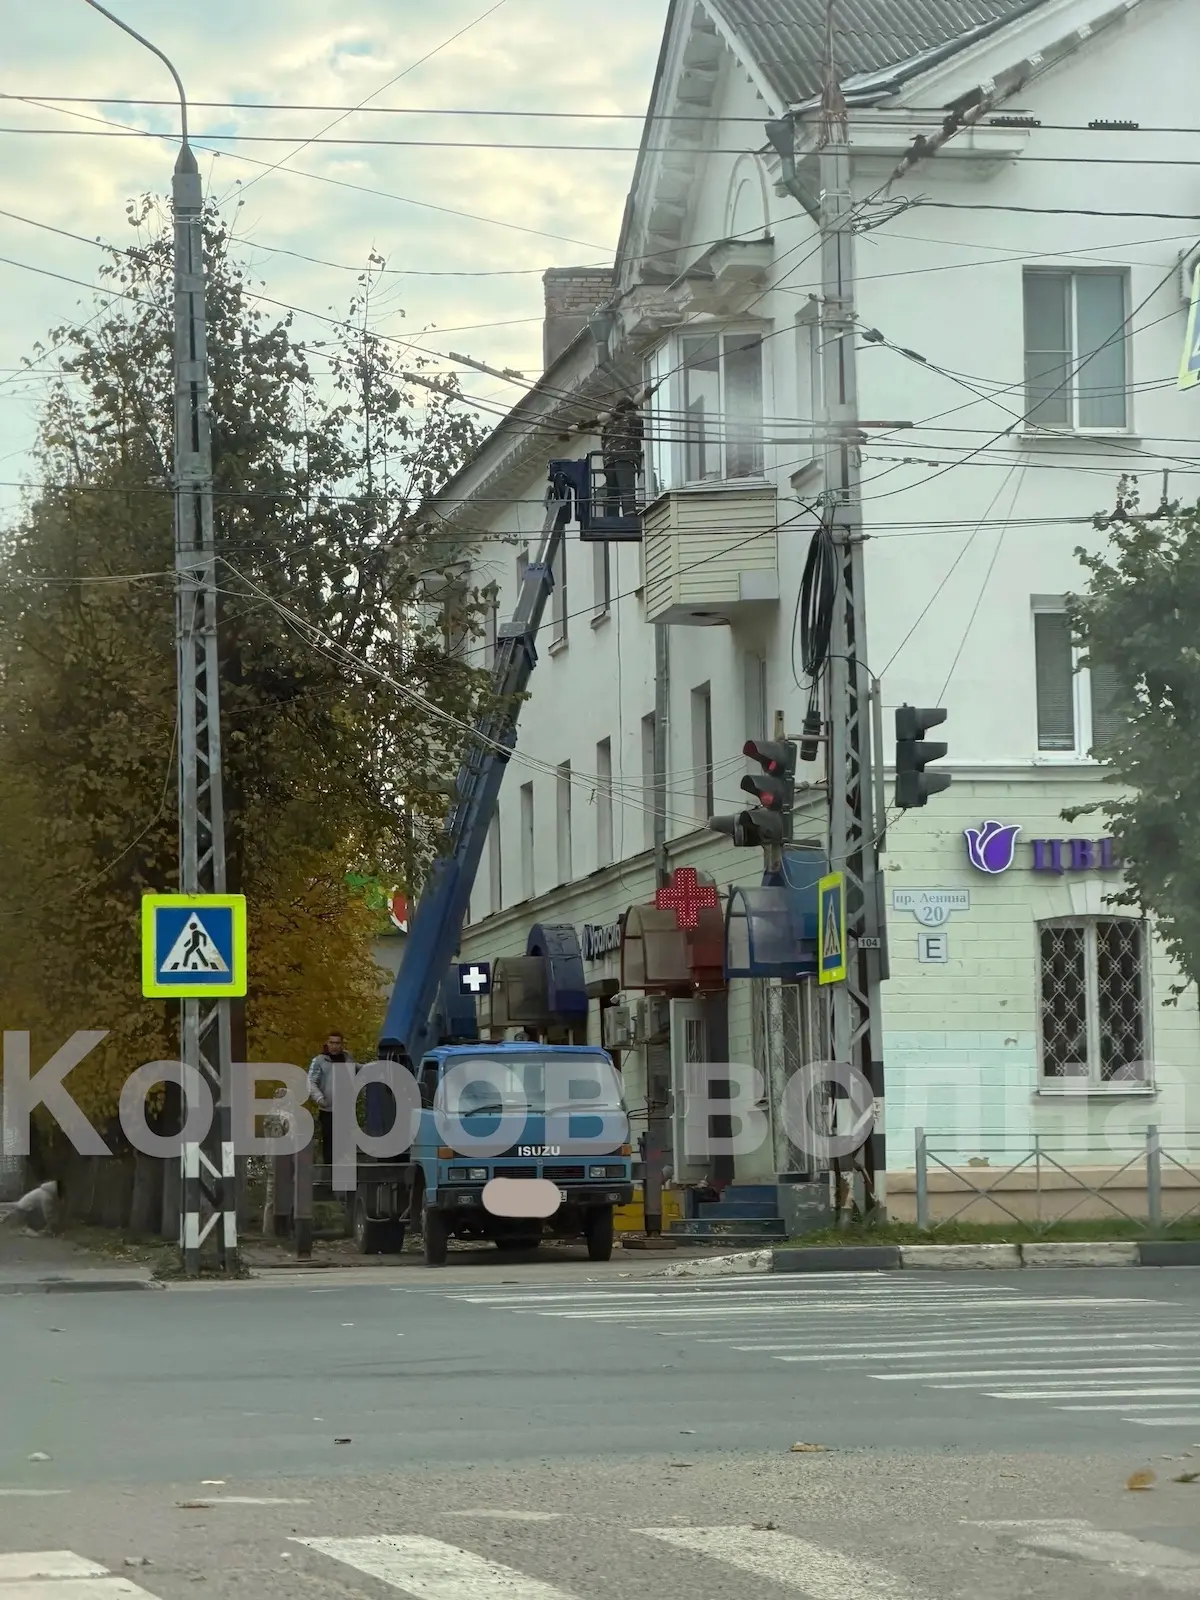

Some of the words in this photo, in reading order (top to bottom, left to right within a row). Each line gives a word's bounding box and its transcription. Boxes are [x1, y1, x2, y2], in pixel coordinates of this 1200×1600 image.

[896, 895, 915, 905] пр.
[920, 892, 966, 903] Ленина
[923, 906, 944, 921] 20
[860, 938, 878, 947] 104
[517, 1145, 561, 1156] ISUZU
